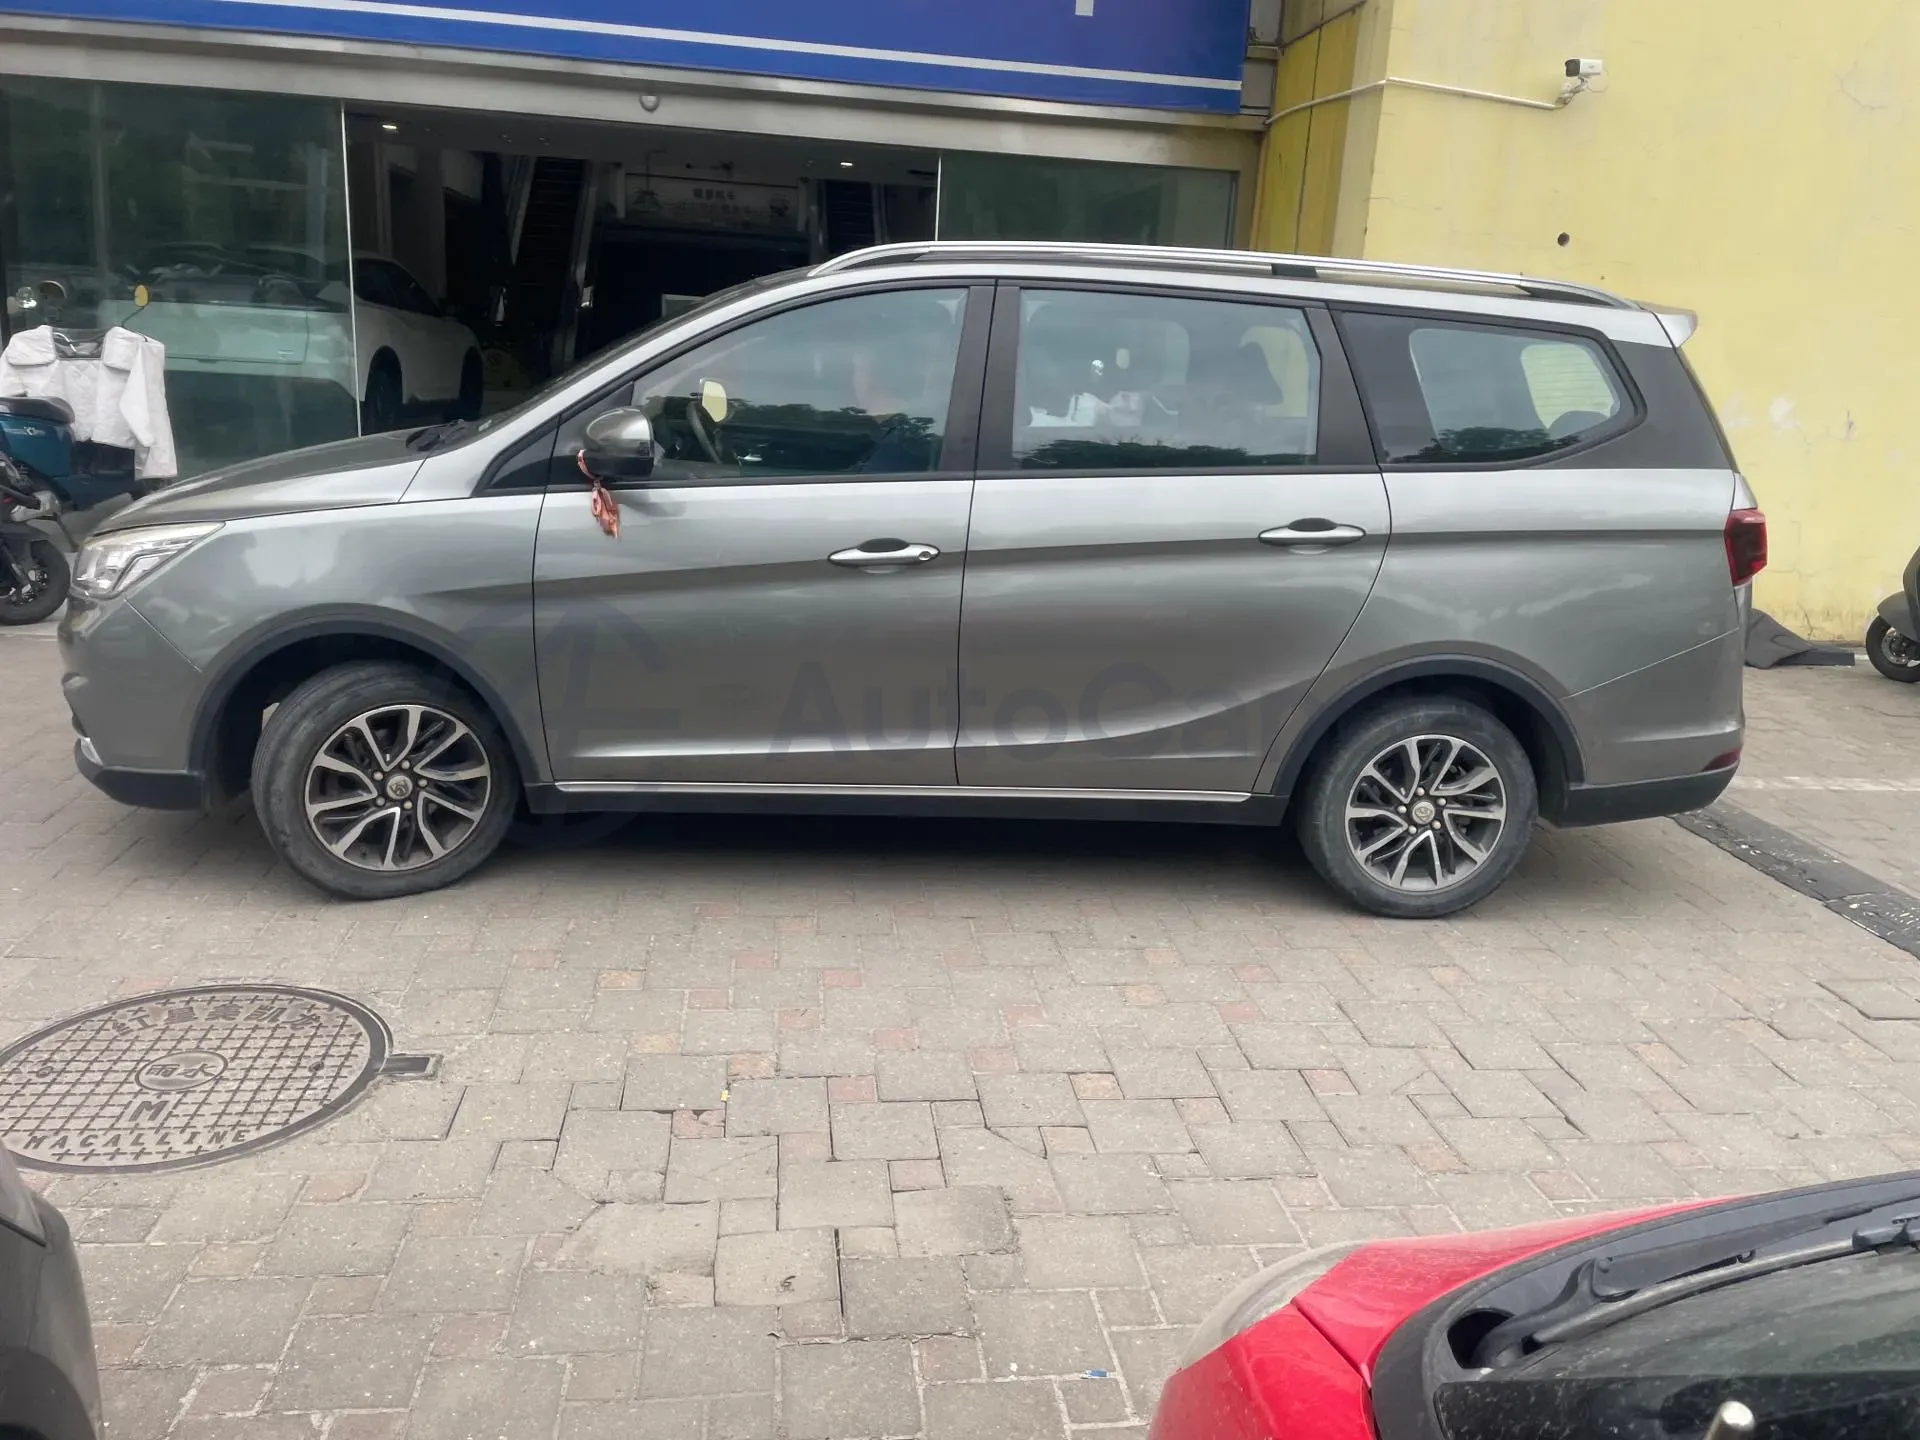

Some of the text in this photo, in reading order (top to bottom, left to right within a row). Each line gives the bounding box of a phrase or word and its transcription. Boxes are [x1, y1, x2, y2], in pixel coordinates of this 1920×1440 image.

[145, 1063, 216, 1078] 雨水
[128, 1100, 169, 1121] M
[23, 1129, 250, 1149] MACALLINE
